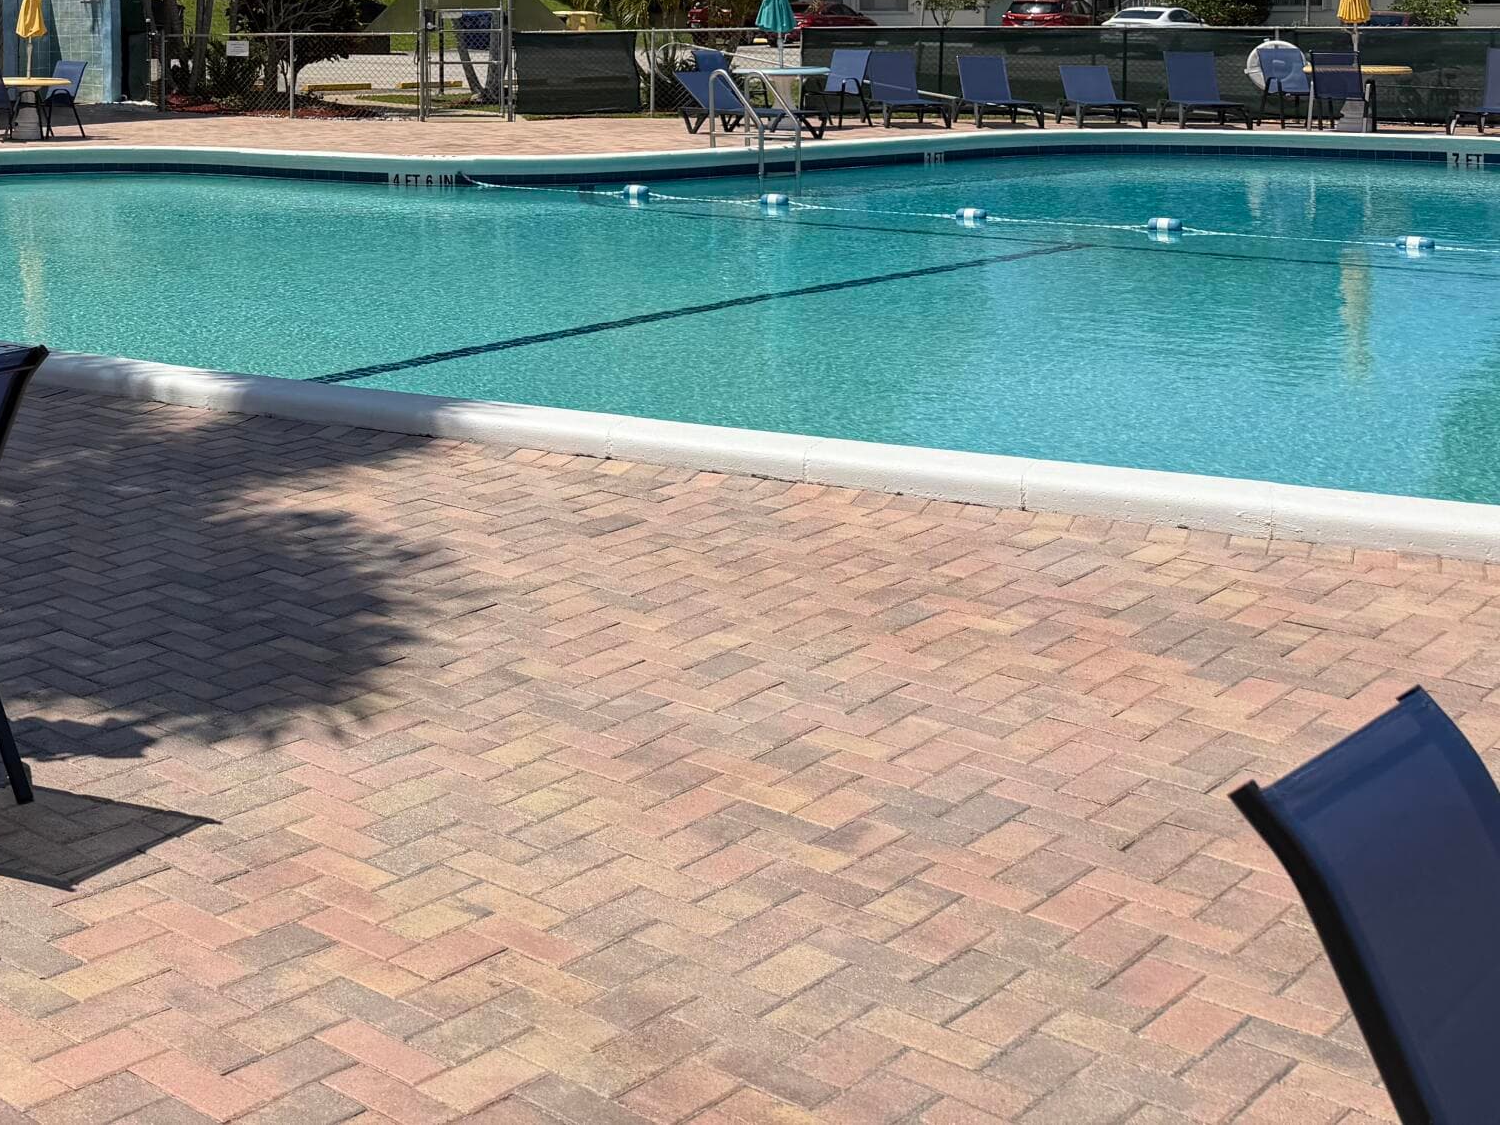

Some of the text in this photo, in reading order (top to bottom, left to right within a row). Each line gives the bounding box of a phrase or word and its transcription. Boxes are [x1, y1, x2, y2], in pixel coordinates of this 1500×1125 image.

[1452, 152, 1482, 163] 7 FT
[393, 174, 453, 186] 4 FT 6 IN
